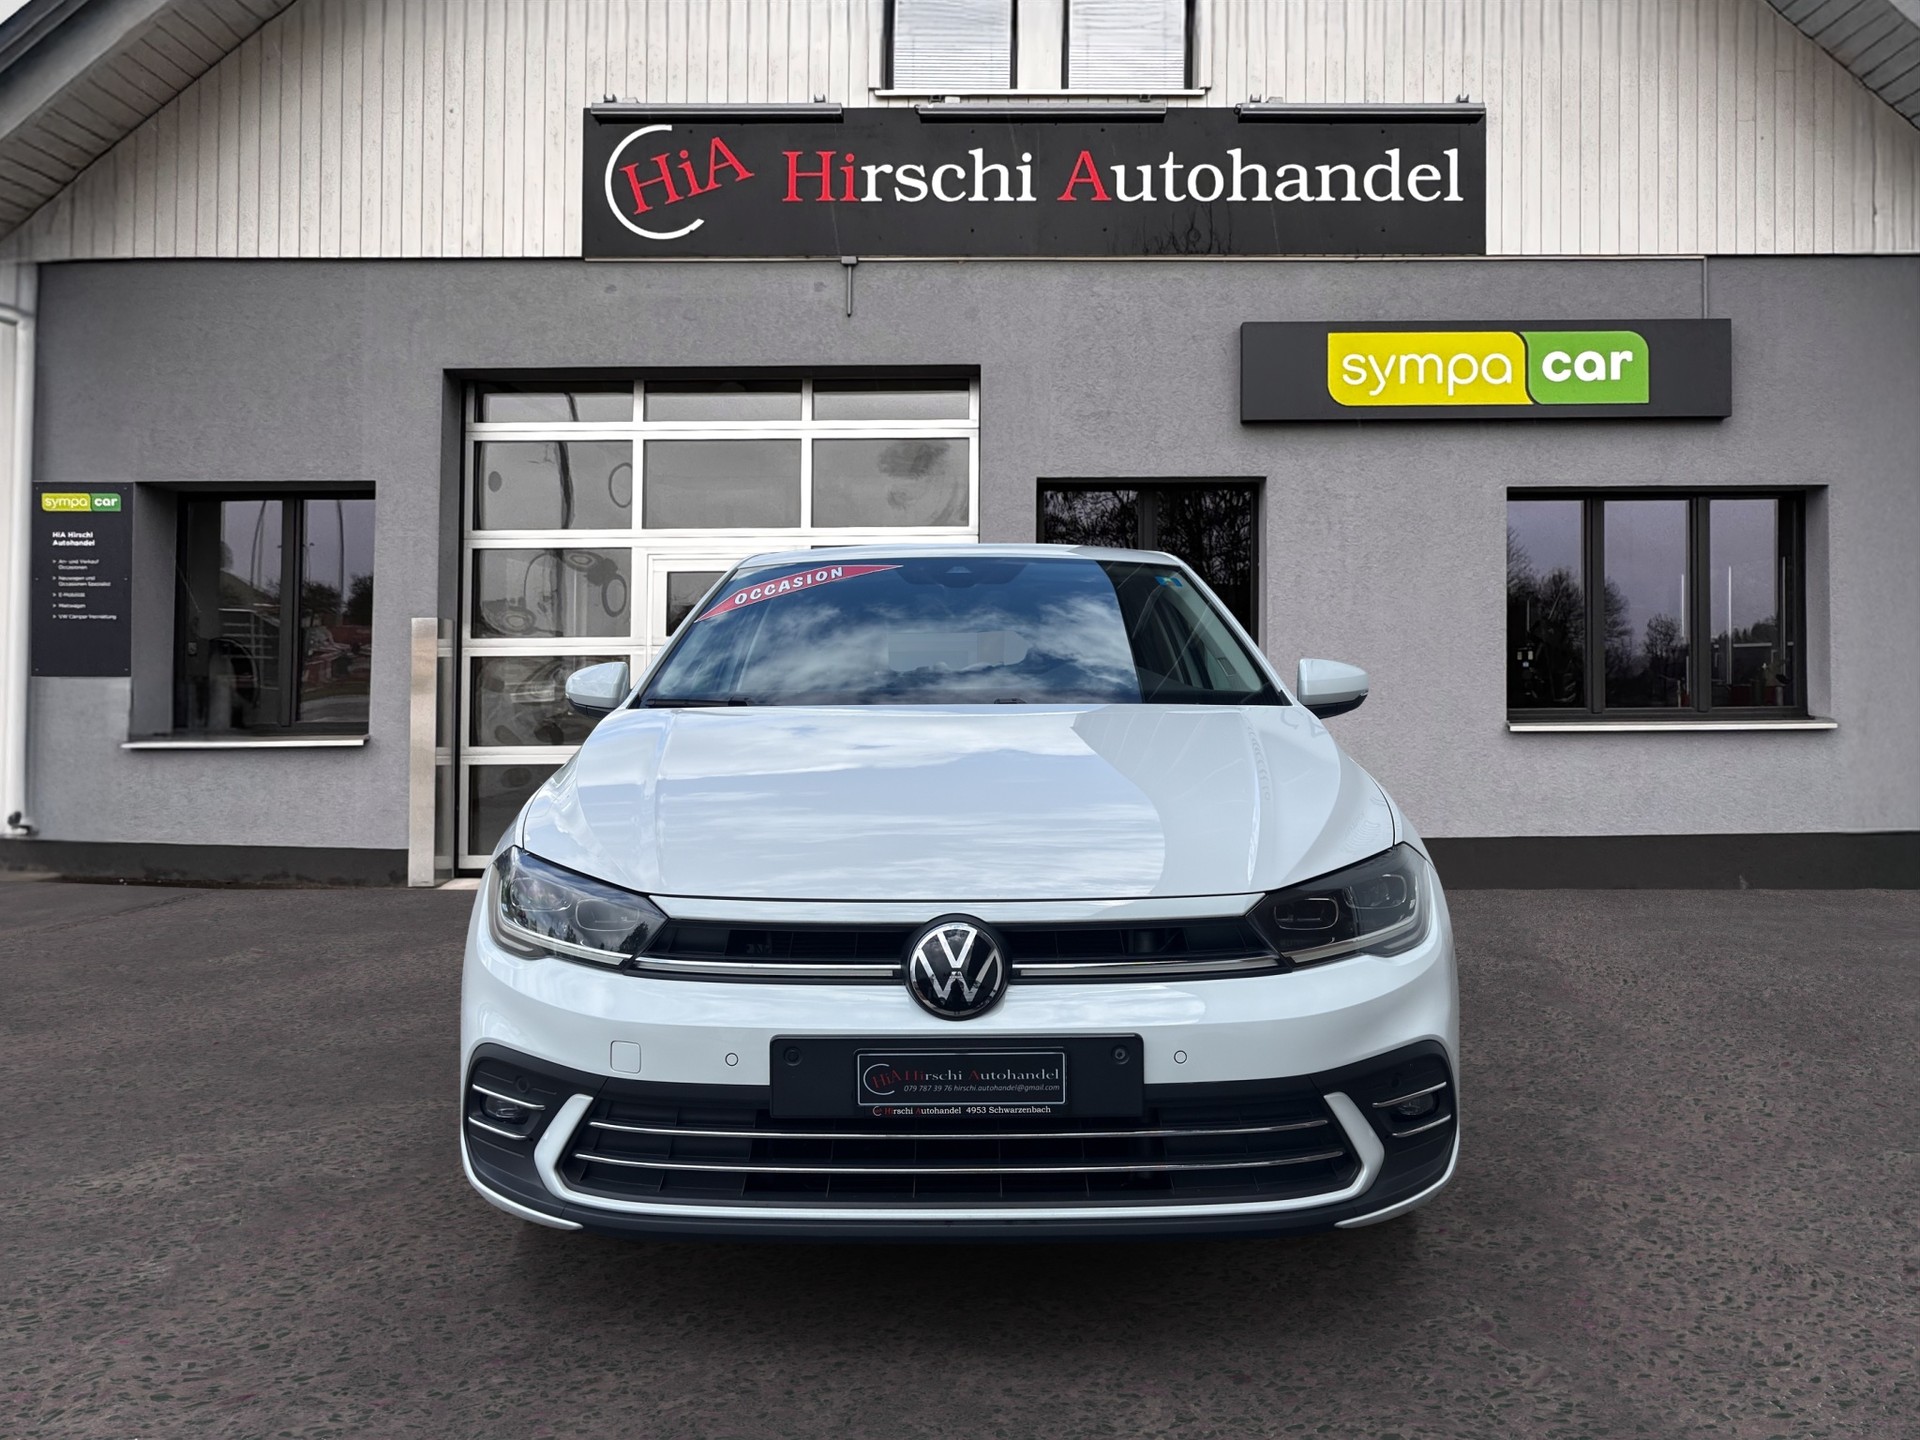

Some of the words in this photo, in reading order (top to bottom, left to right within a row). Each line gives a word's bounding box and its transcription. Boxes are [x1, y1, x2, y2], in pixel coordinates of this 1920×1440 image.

[619, 136, 755, 215] HiA
[781, 147, 1037, 203] Hirschi
[1057, 147, 1465, 202] Autohandel
[1341, 352, 1513, 396] sympa
[1541, 350, 1633, 383] car
[44, 497, 88, 509] sympa
[94, 496, 118, 507] car
[734, 566, 844, 606] OCCASION
[905, 1069, 963, 1081] Hirschi
[968, 1068, 1060, 1081] Autohandel
[953, 1083, 1060, 1093] hirschi.autohandel@gmail.com
[915, 1106, 962, 1115] Autohandel
[966, 1106, 987, 1114] 4953
[988, 1105, 1051, 1114] Schwarzenbach
